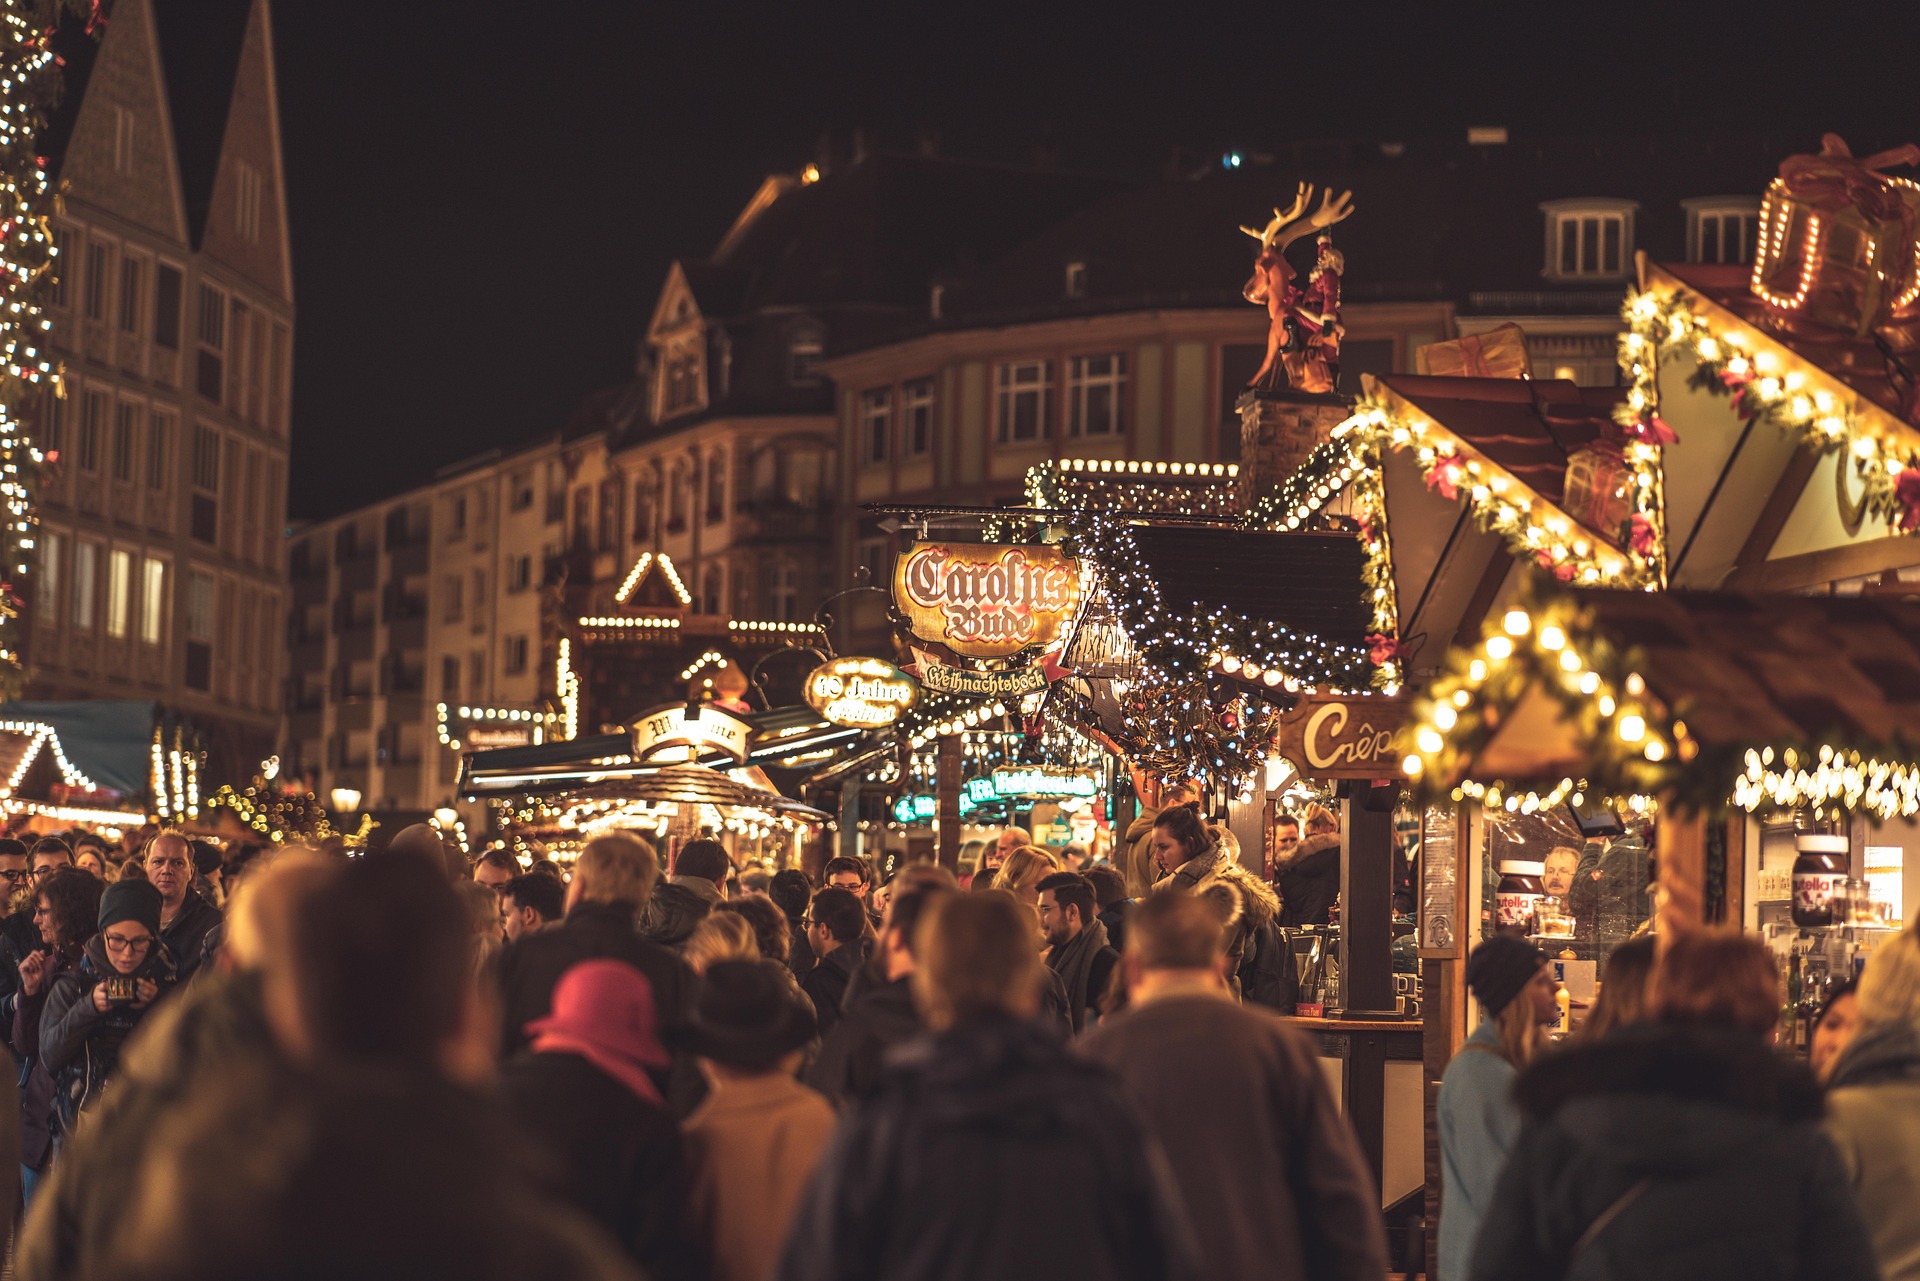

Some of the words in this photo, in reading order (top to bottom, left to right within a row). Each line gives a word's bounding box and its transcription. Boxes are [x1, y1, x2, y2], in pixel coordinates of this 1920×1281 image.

[909, 549, 1069, 606] Carolus
[945, 604, 1031, 637] Bude
[926, 664, 1046, 697] Weihnachtsbock
